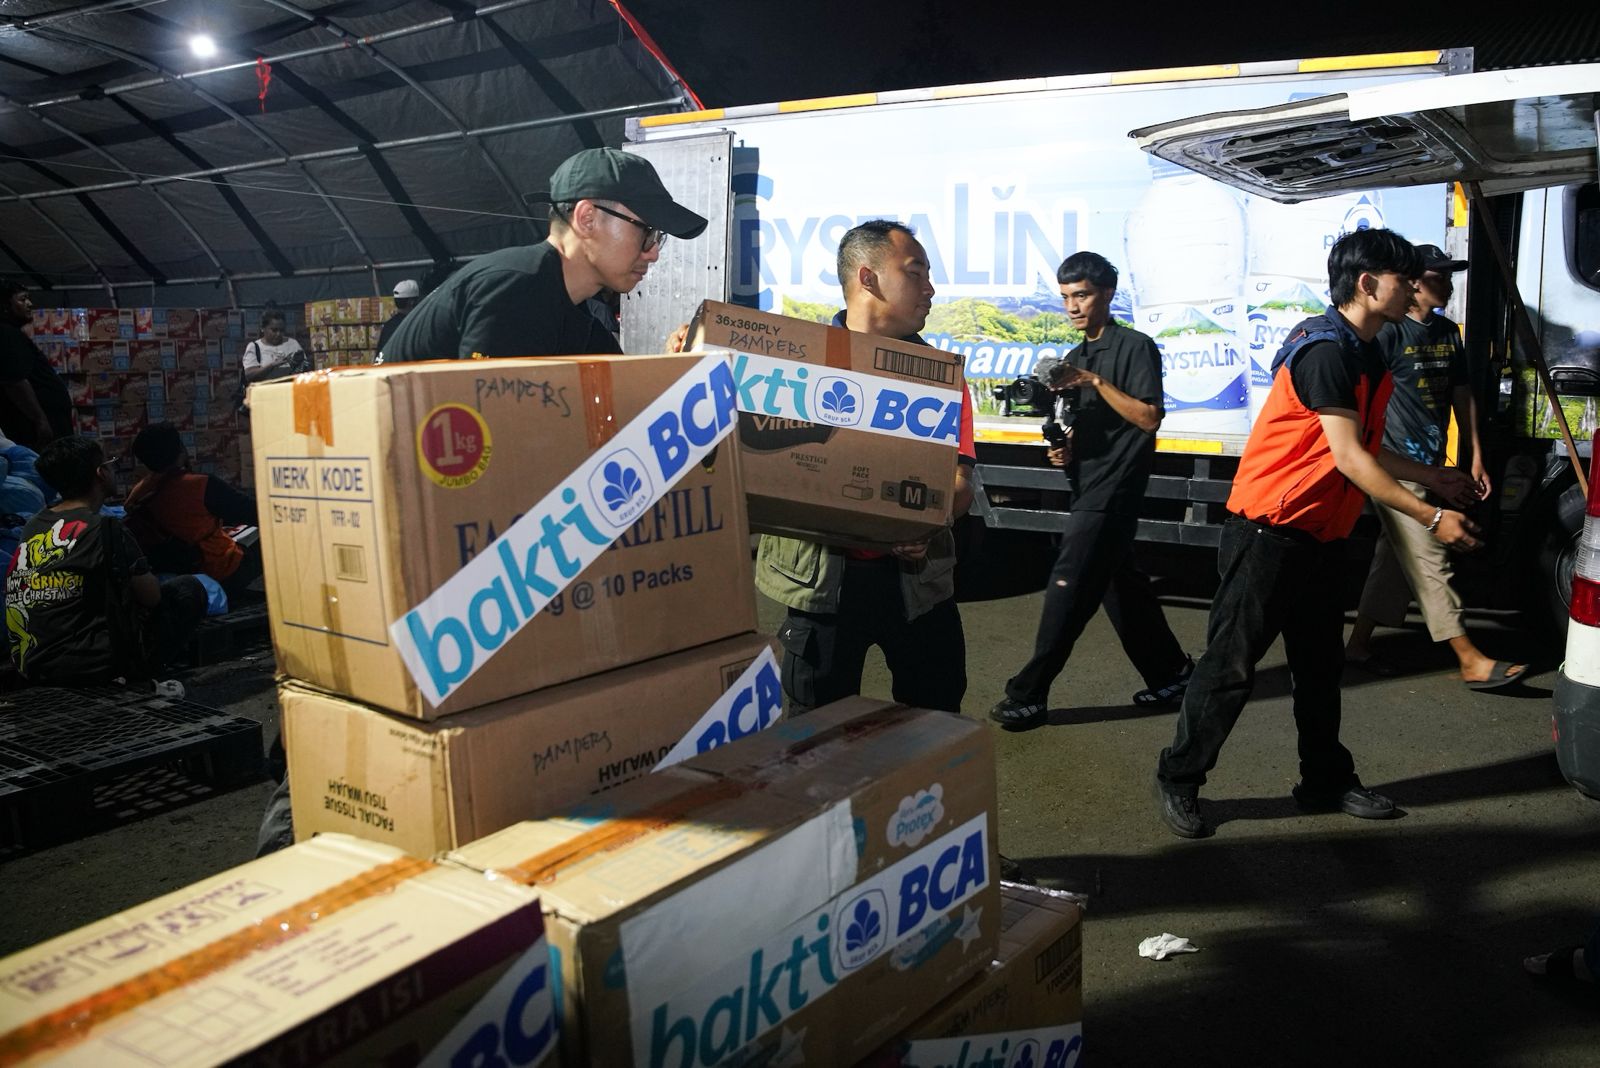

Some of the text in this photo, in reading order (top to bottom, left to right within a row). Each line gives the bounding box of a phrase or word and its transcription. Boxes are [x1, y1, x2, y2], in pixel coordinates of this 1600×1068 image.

[715, 313, 781, 336] 36x360PLY
[728, 329, 807, 359] PAMPERS
[731, 355, 961, 443] kti BCA
[648, 359, 737, 483] BCA
[439, 446, 492, 487] JUMBO BAG
[790, 451, 829, 464] PRESTIGE
[852, 465, 871, 474] SOFT
[272, 465, 364, 492] MERK KODE
[887, 486, 894, 497] S
[904, 486, 922, 505] M
[31, 572, 84, 590] GRINCH
[406, 487, 610, 698] bakti
[602, 573, 625, 598] 10
[632, 562, 694, 592] Packs
[598, 750, 655, 783] WAJAH
[324, 796, 394, 832] FACIAL TISSUE
[650, 914, 839, 1068] bakti
[896, 828, 986, 938] BCA
[451, 964, 552, 1068] BC
[1044, 1035, 1081, 1068] BC
